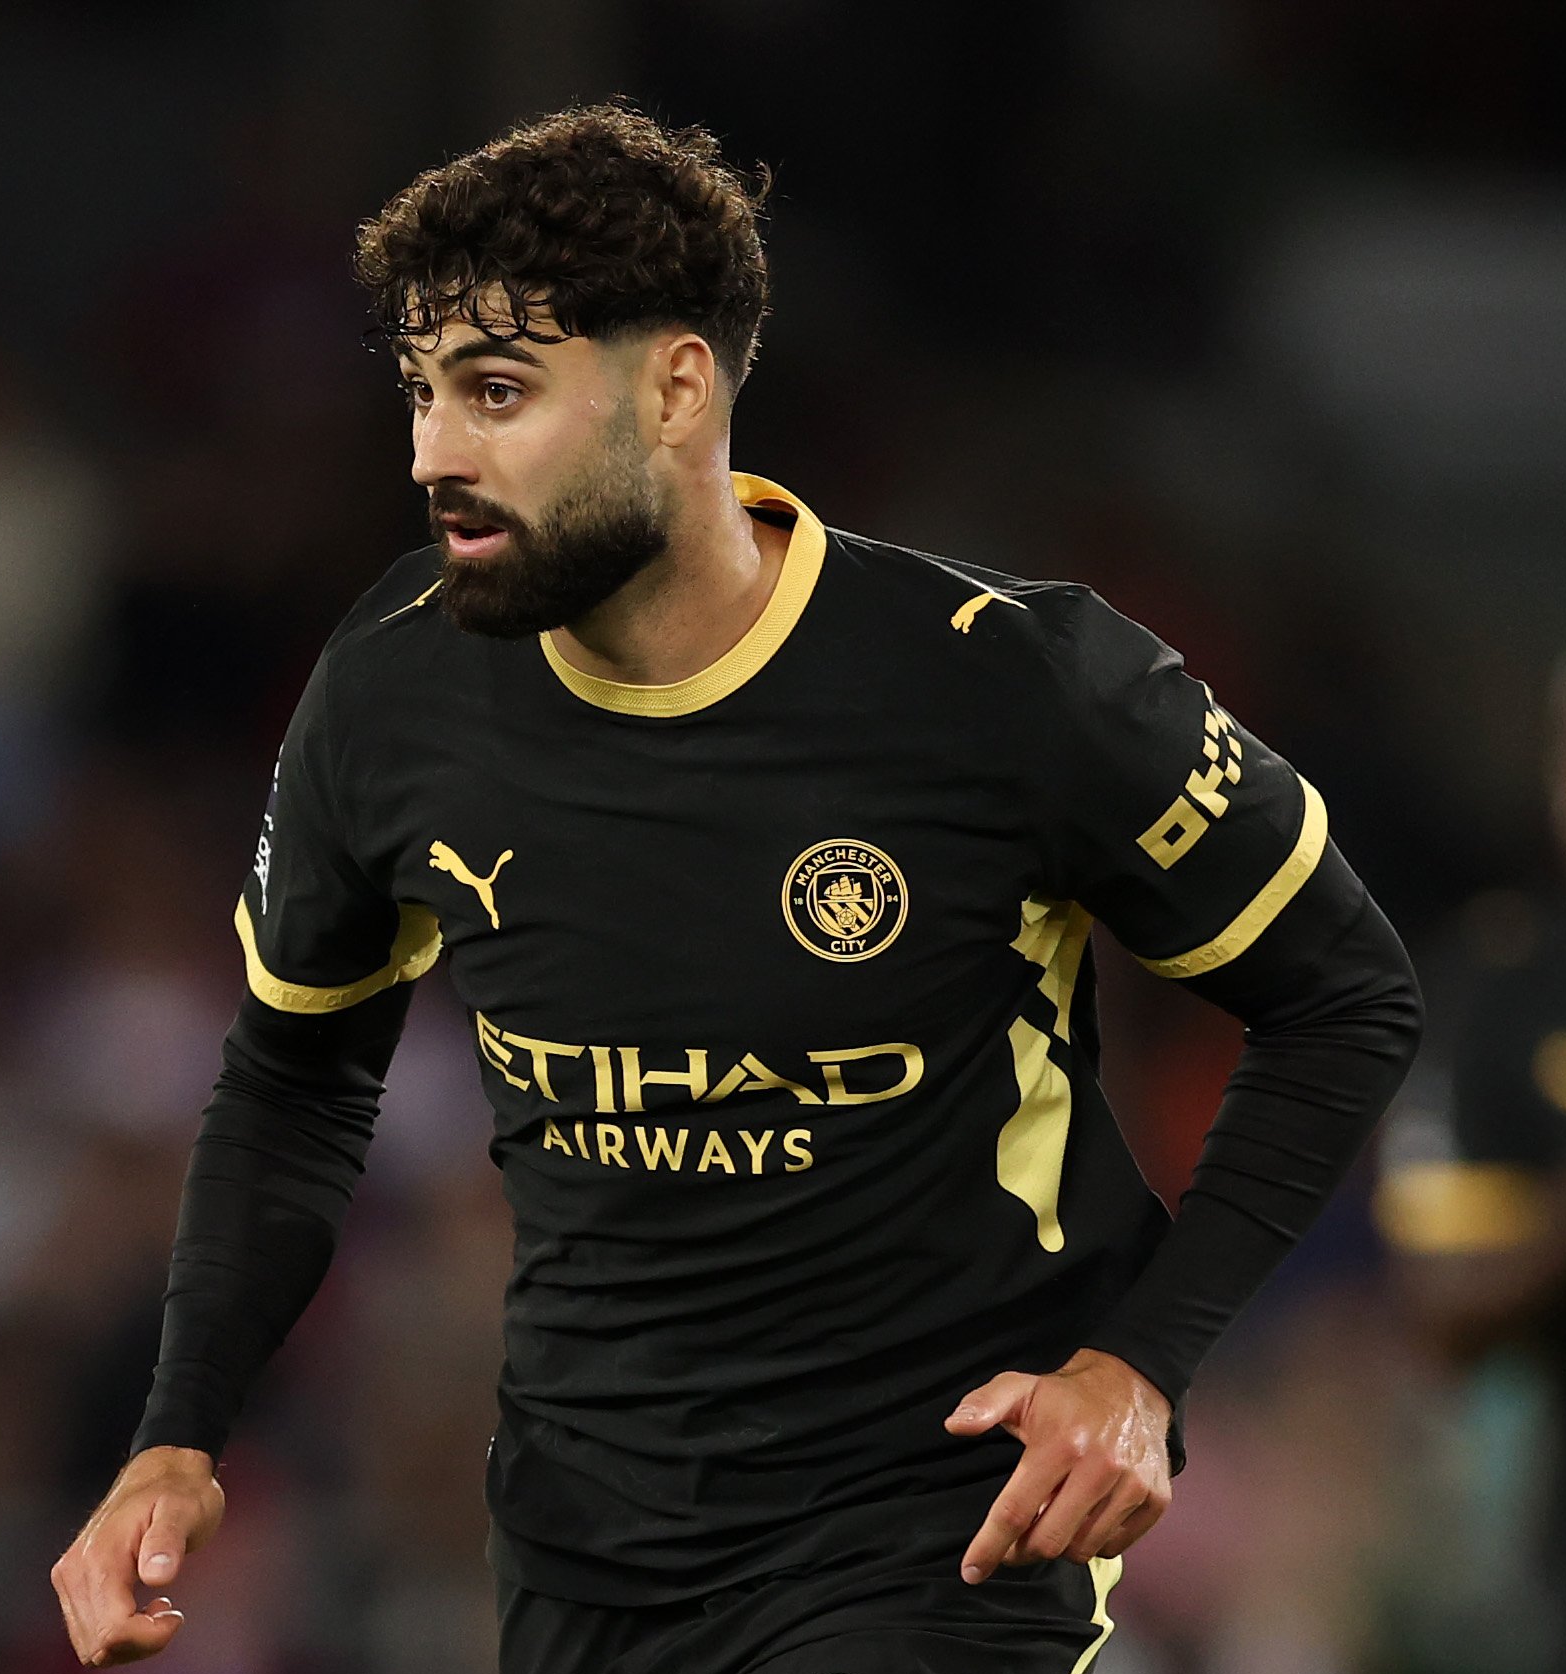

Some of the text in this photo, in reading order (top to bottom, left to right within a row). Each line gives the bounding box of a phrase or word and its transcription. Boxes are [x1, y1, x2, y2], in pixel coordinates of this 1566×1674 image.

[1136, 681, 1243, 871] OKX
[795, 848, 893, 886] MANCHESTER
[793, 894, 899, 905] 18 94
[830, 939, 867, 952] CITY
[475, 1010, 925, 1113] ETIHAD
[542, 1120, 815, 1174] AIRWAYS
